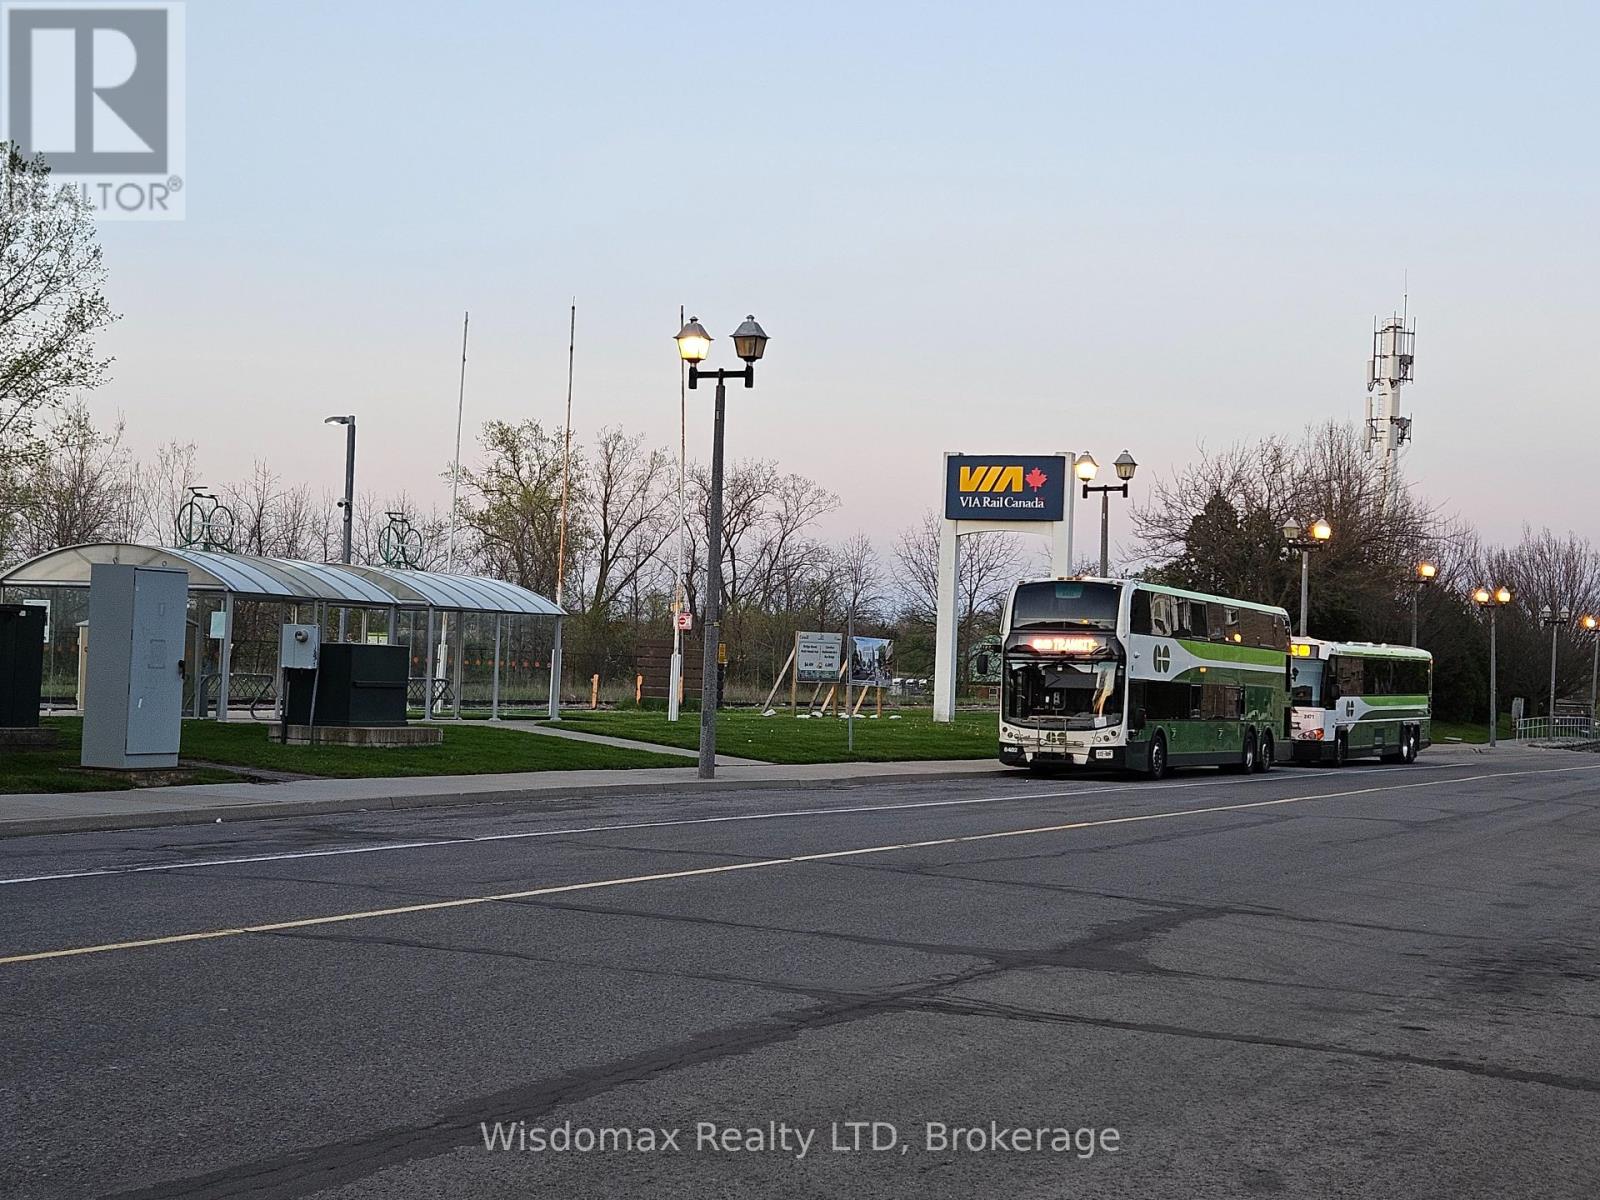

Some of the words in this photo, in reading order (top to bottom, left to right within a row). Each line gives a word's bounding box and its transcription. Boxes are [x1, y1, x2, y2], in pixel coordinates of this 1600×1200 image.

[960, 466, 1024, 492] VIA
[960, 497, 981, 508] VIA
[982, 496, 1003, 508] Rail
[1004, 496, 1044, 508] Canada
